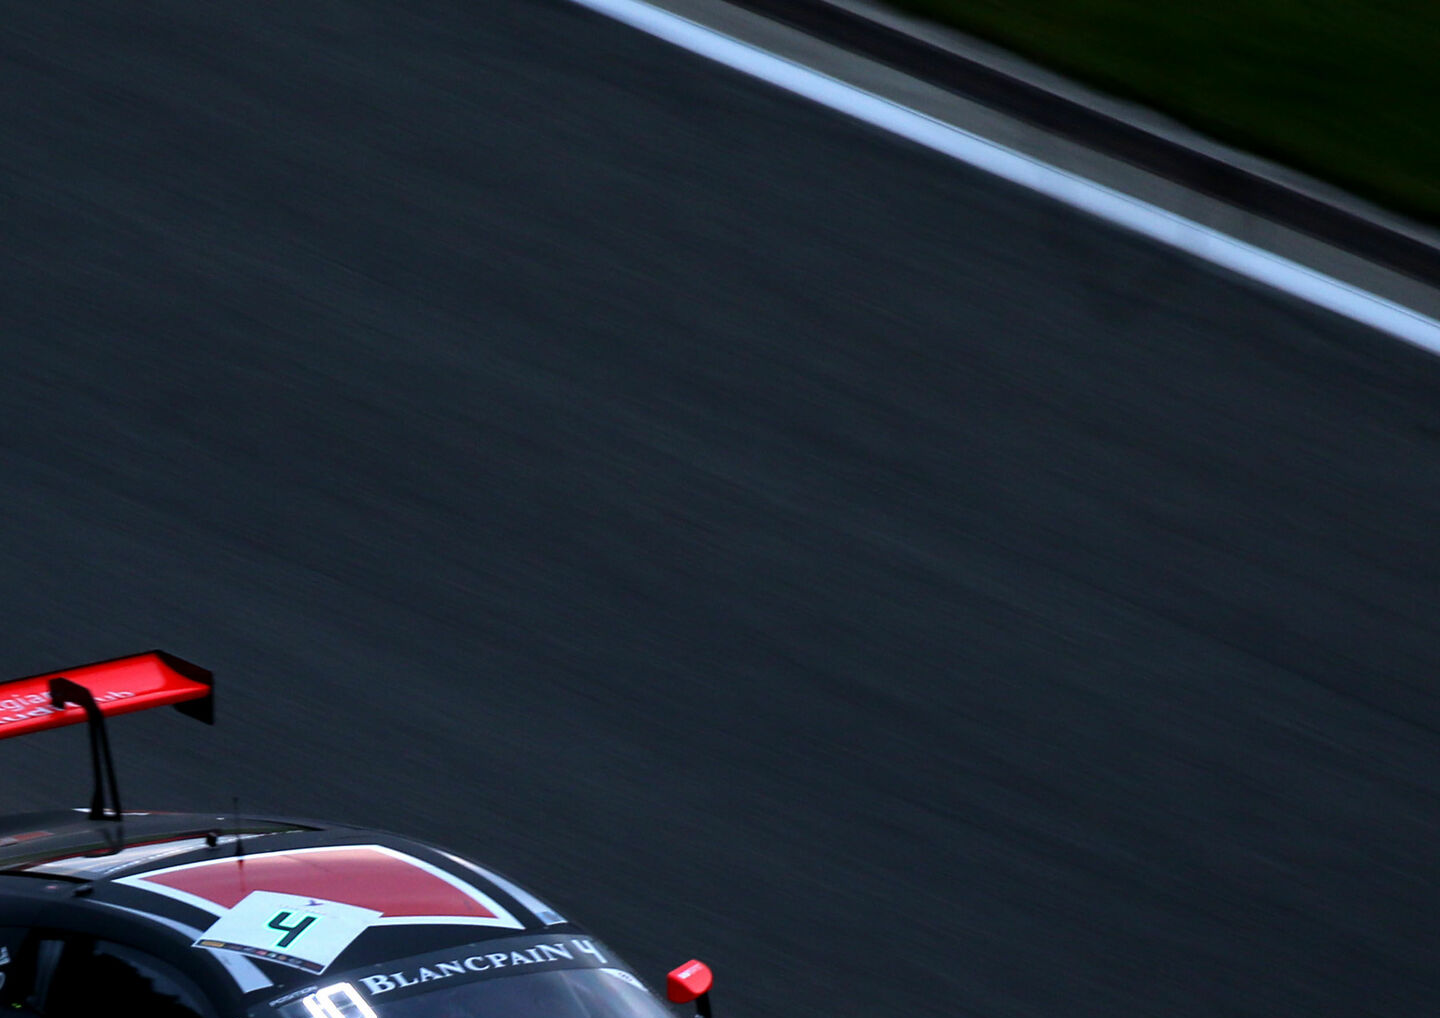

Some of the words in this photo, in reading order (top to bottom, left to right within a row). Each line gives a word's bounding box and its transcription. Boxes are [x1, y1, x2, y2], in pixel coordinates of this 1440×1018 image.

[267, 911, 320, 949] 4
[359, 942, 574, 996] BLANCPAIN
[571, 938, 608, 965] 4
